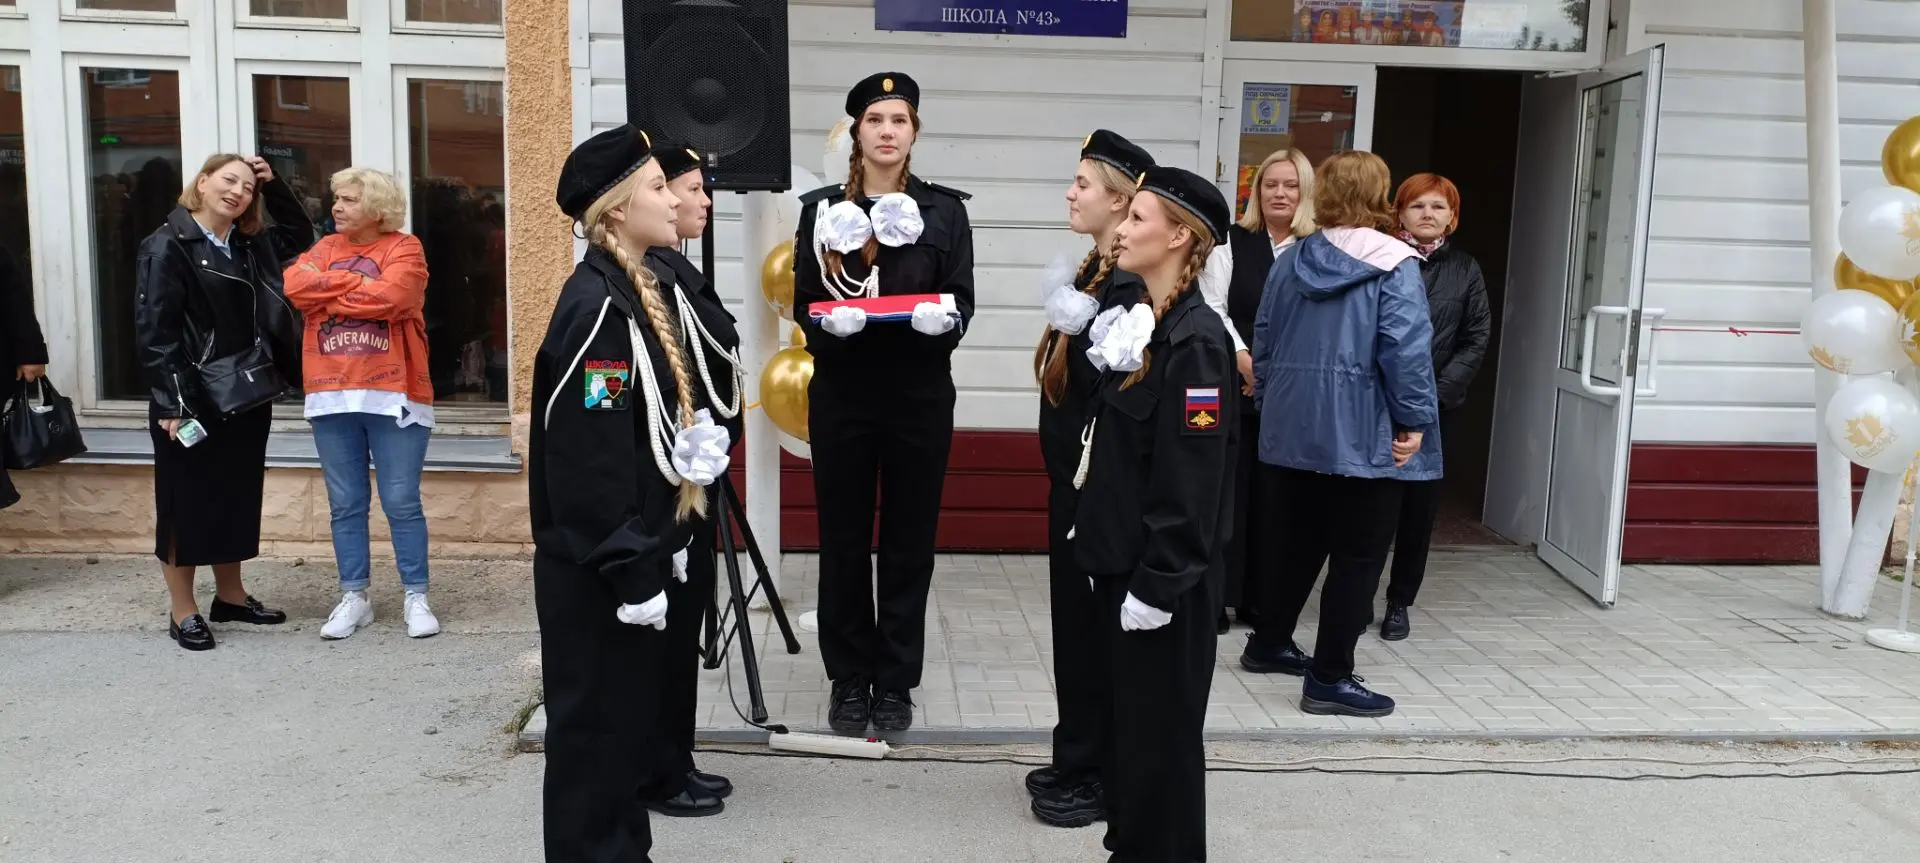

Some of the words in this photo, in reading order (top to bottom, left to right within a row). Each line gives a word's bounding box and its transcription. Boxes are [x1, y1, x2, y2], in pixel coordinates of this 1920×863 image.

[942, 7, 1007, 25] ШКОЛА
[1016, 10, 1061, 26] №43»
[323, 331, 389, 353] NEVERMIND
[585, 359, 628, 370] ШКОЛА
